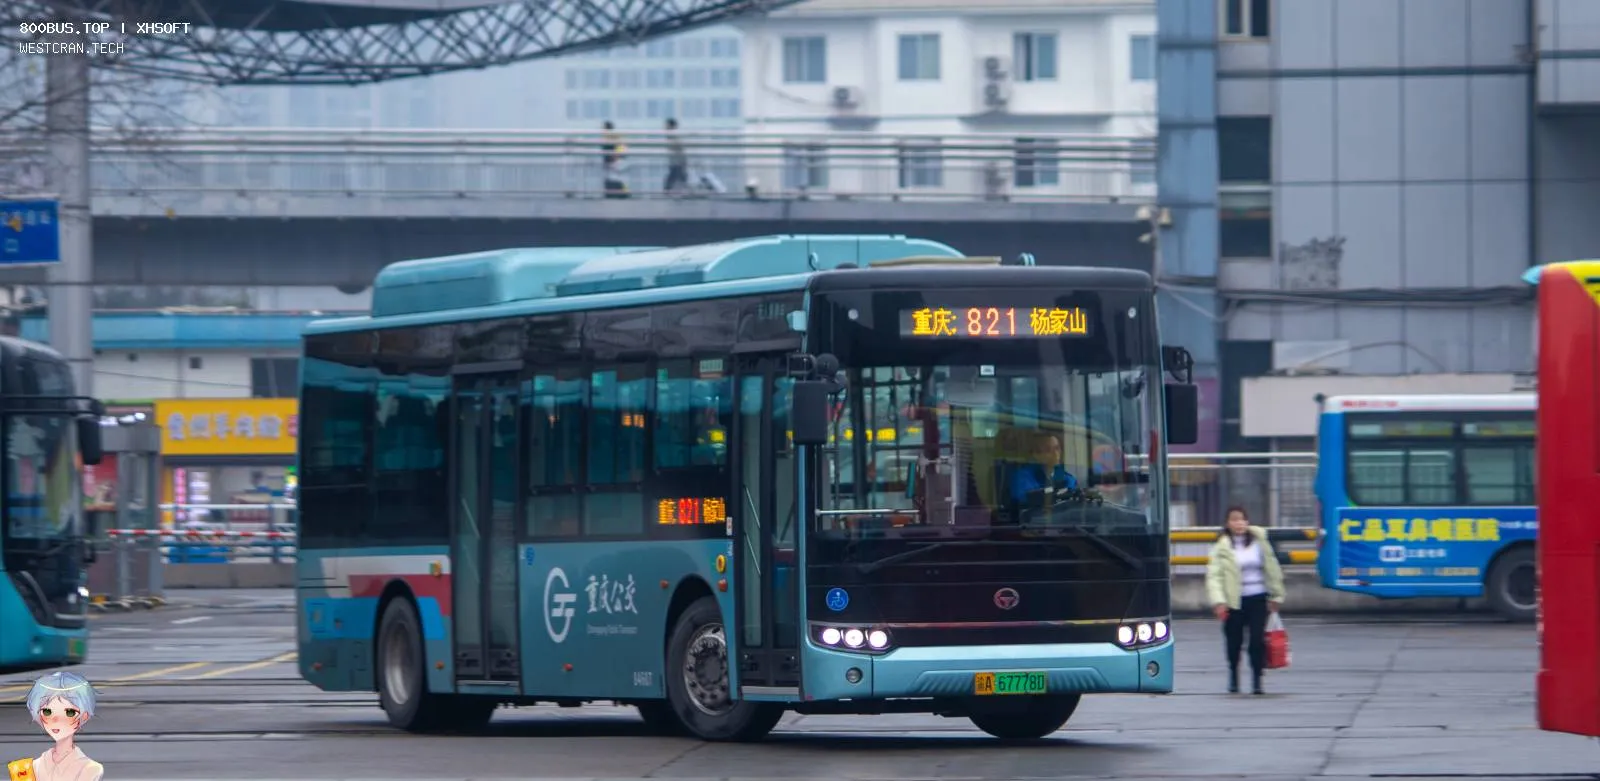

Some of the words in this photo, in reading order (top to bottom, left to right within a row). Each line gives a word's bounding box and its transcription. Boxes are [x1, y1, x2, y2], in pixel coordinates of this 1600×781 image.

[967, 307, 1016, 335] 821
[1030, 307, 1087, 335] 杨家山
[584, 574, 638, 614] 重庆公交
